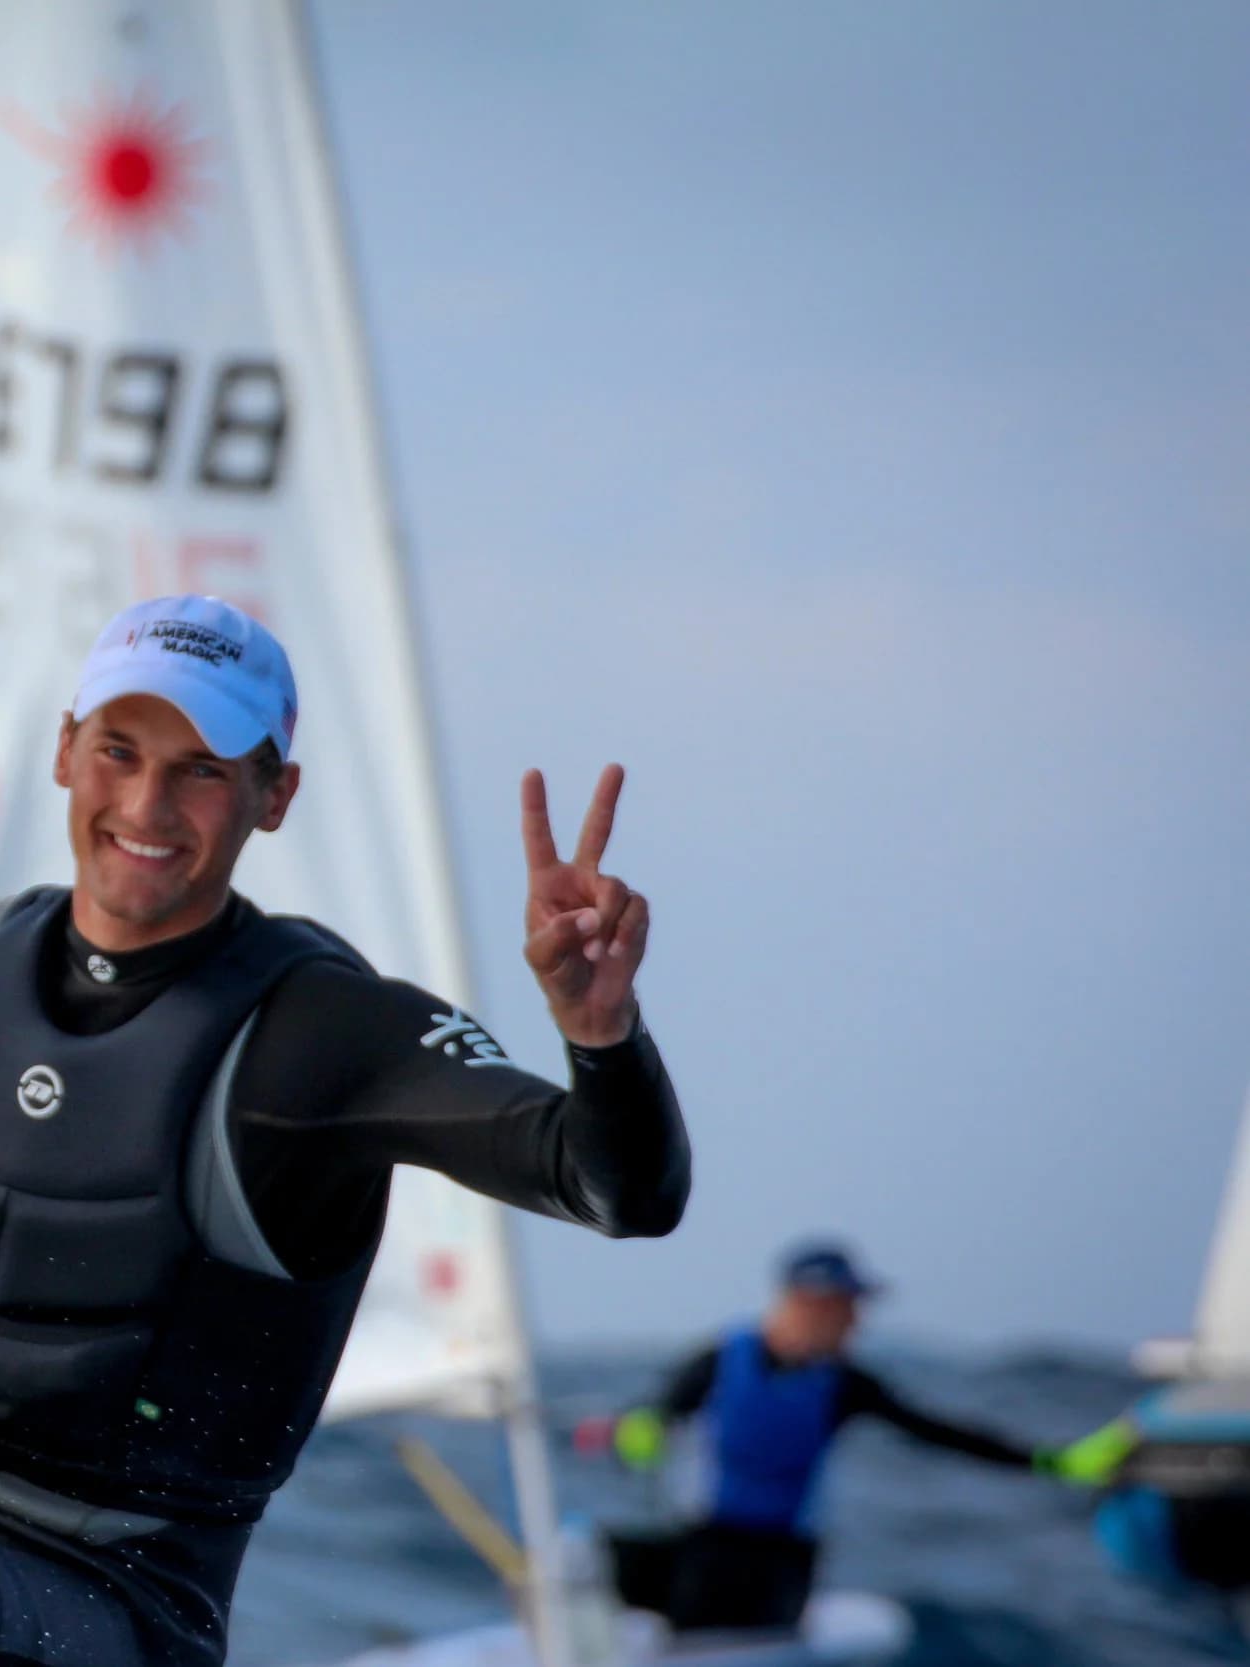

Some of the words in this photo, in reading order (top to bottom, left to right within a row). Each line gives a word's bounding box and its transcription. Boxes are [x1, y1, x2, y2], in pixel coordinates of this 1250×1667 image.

[149, 626, 243, 662] AMERICAN
[161, 639, 222, 668] MAGIC
[420, 1008, 509, 1067] hik
